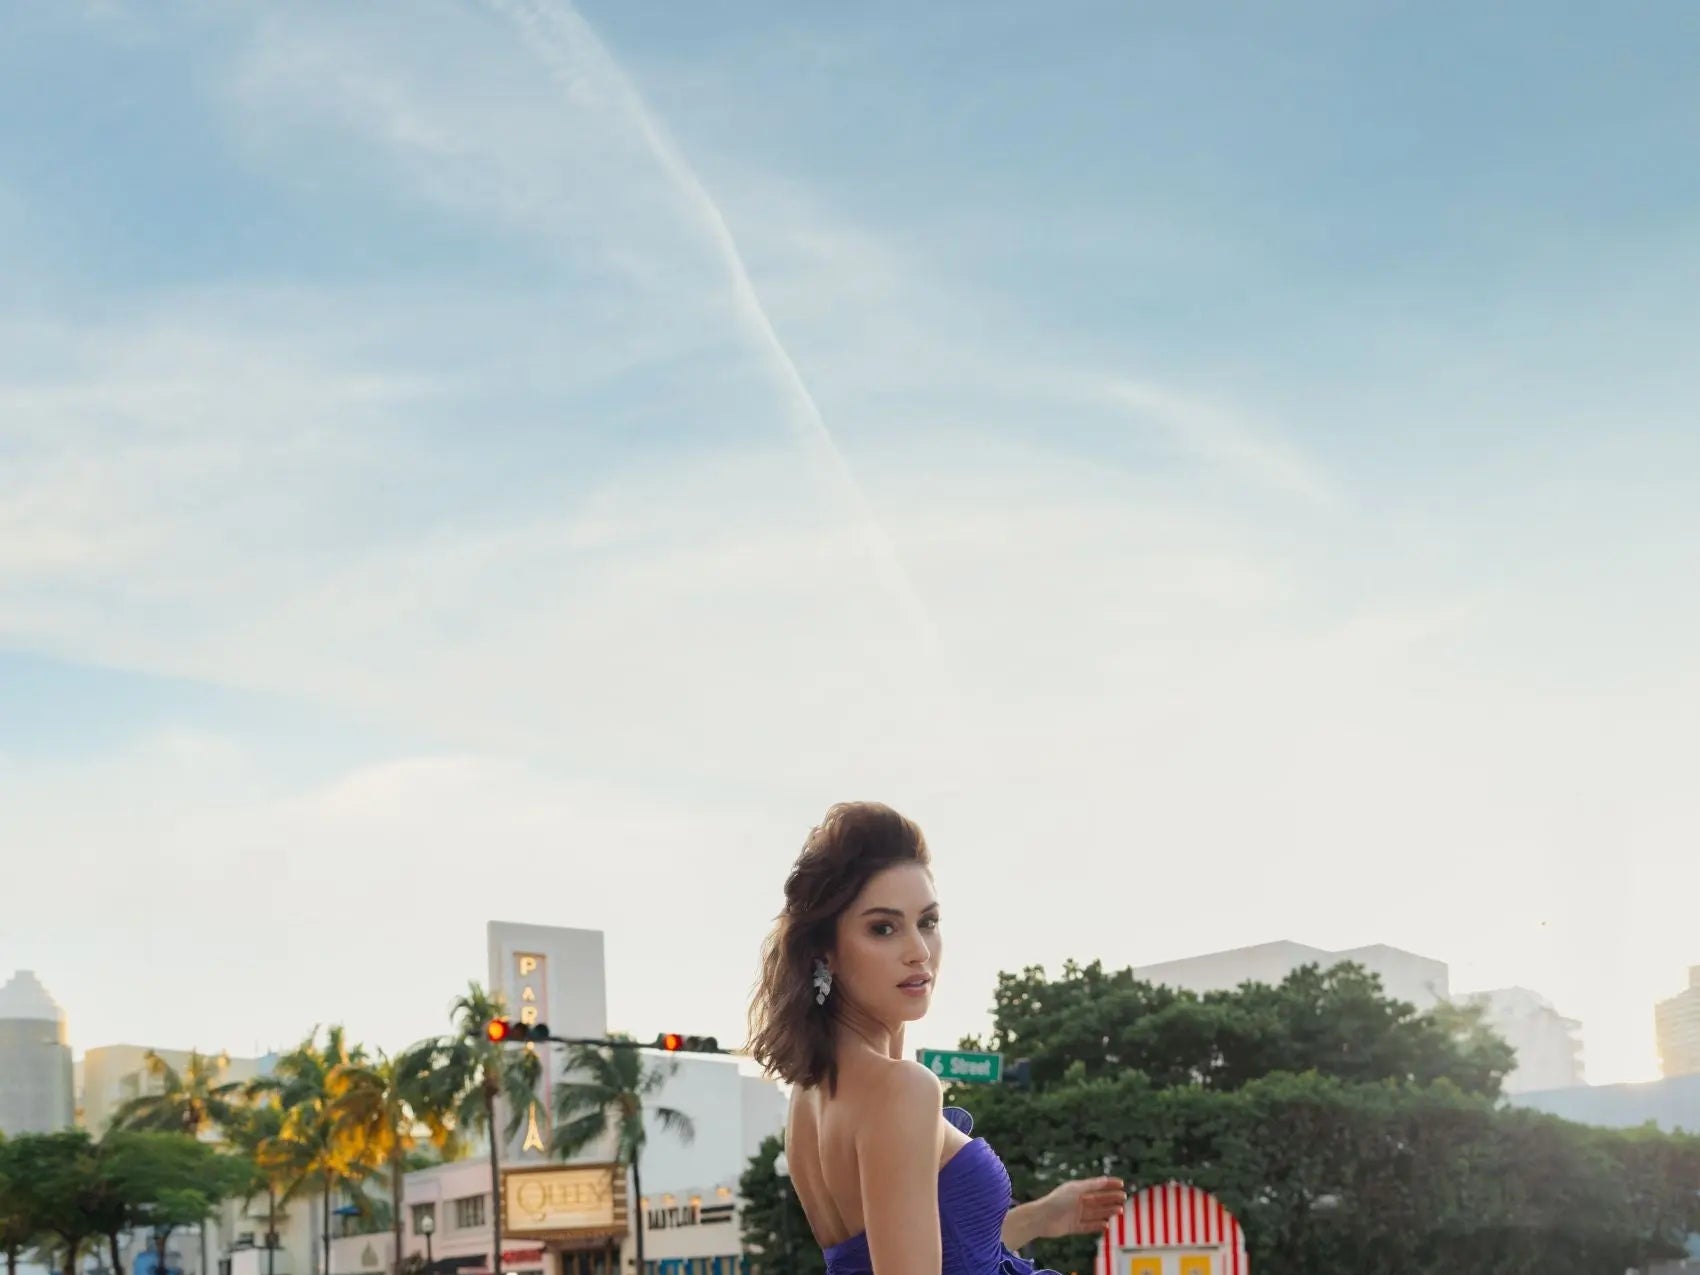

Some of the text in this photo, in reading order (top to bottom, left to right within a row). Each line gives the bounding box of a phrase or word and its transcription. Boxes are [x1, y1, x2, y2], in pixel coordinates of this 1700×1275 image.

[519, 956, 538, 1050] PAR
[931, 1055, 991, 1076] 6 Street
